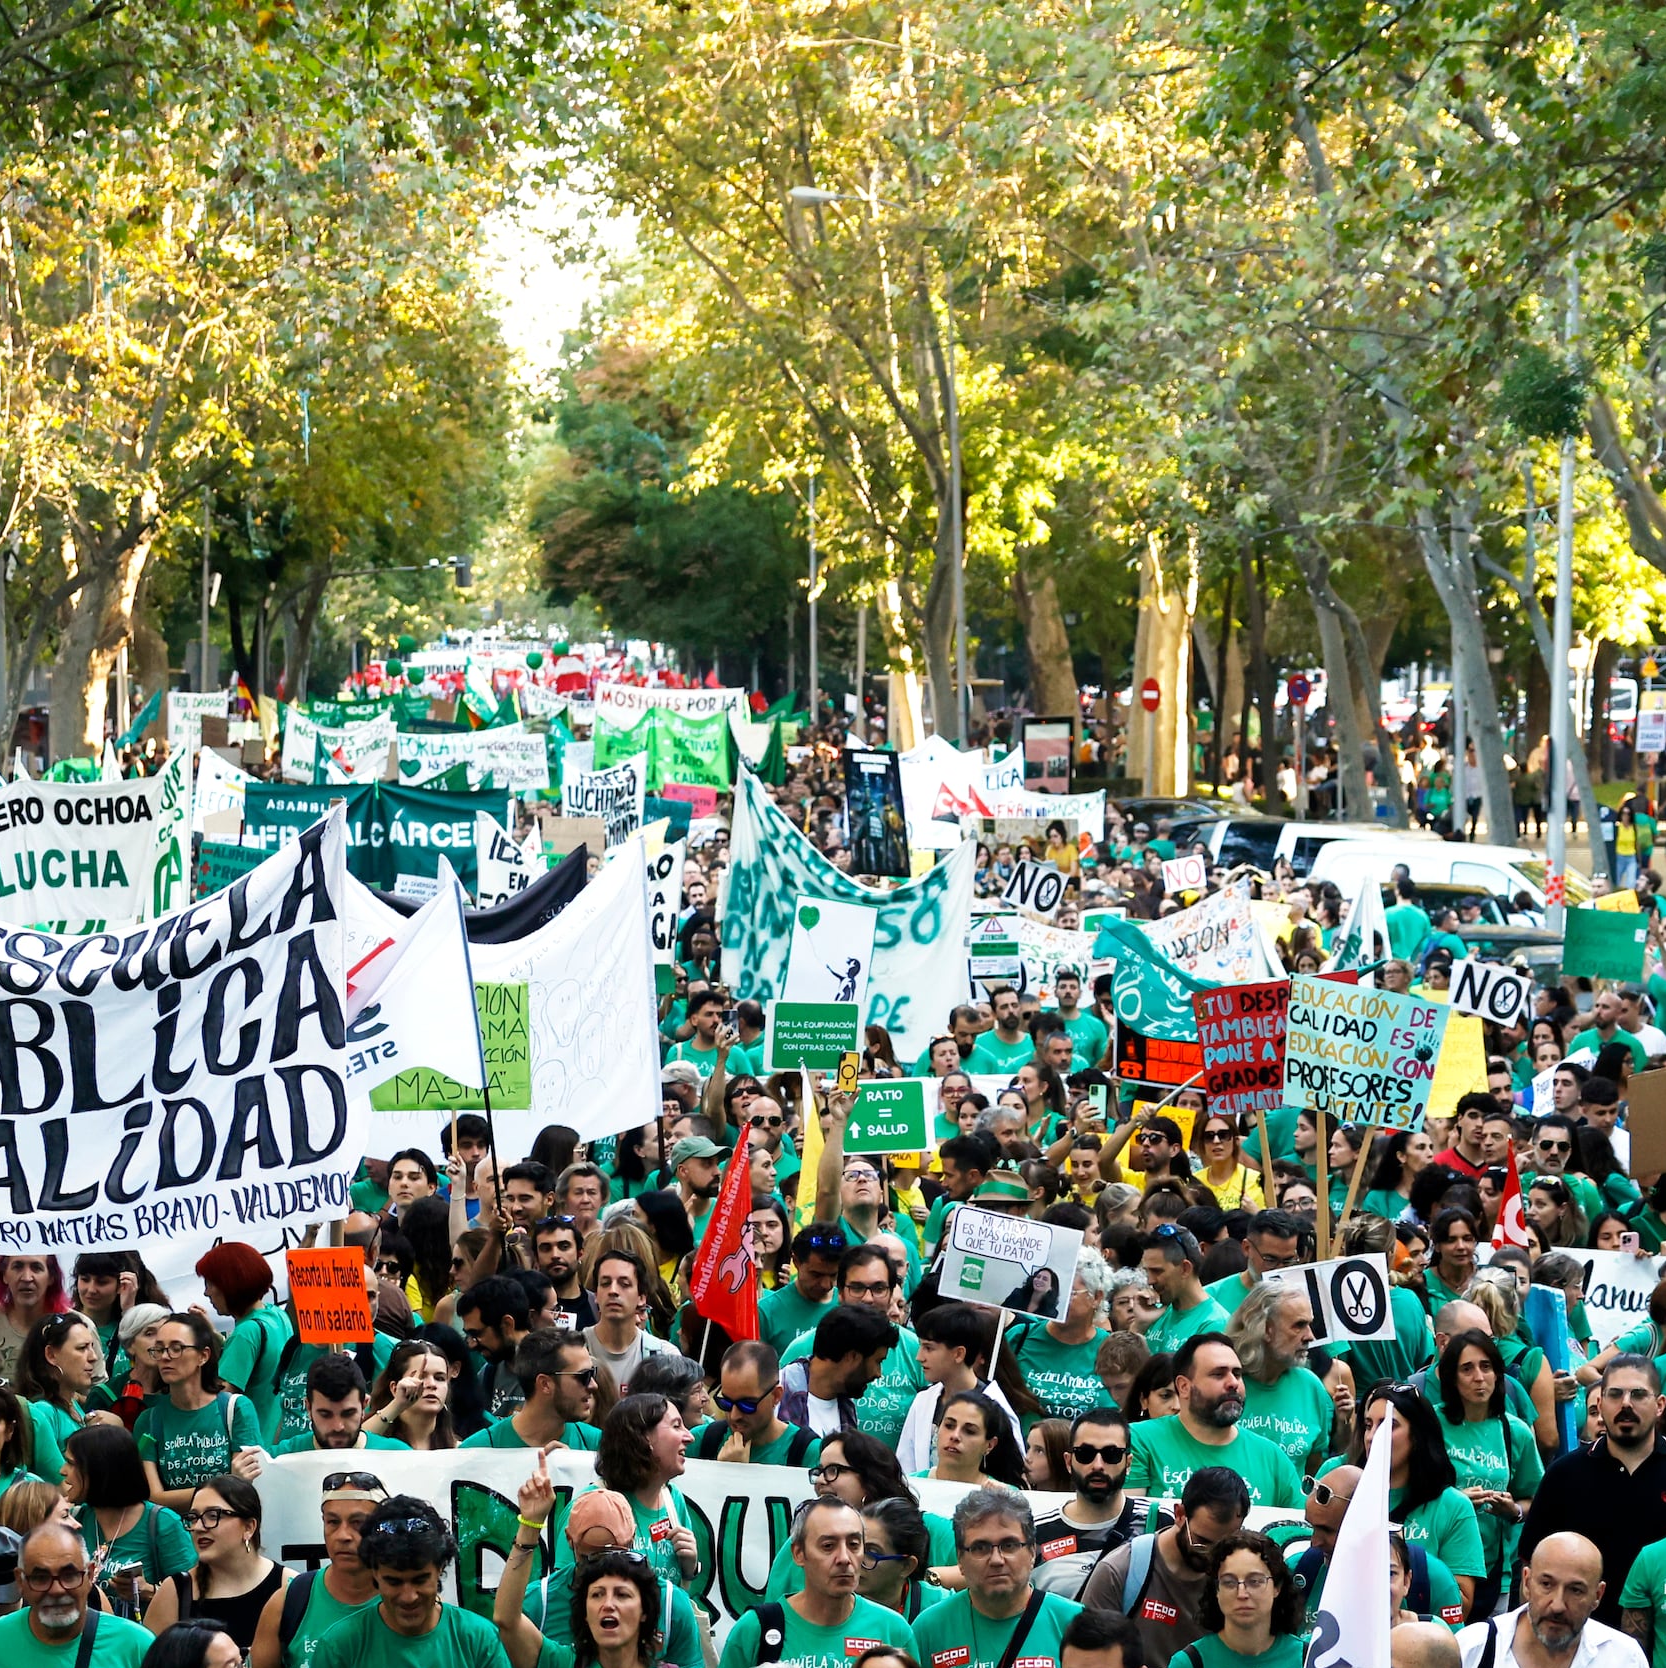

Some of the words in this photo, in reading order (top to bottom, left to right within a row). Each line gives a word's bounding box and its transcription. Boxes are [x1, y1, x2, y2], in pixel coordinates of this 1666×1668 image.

[53, 794, 153, 827] OCHOA
[1165, 860, 1202, 887] NO
[1453, 963, 1521, 1019] NO
[1289, 1005, 1378, 1043] CALIDAD
[1390, 1028, 1416, 1050] ES
[1410, 1007, 1437, 1028] DE
[1204, 1041, 1255, 1070] PONE
[1262, 1041, 1277, 1061] A
[1289, 1031, 1389, 1070] EDUCACIÓN
[1392, 1056, 1435, 1081] CON
[1209, 1065, 1280, 1094] GRADOS
[1287, 1058, 1414, 1104] PROFESORES
[867, 1089, 903, 1103] RATIO
[867, 1122, 909, 1137] SALUD
[133, 1193, 219, 1240] BRAVO
[966, 1239, 985, 1251] QUE
[991, 1240, 1002, 1254] TU
[1003, 1244, 1034, 1261] PATIO
[1002, 1232, 1043, 1252] GRANDE
[298, 1309, 313, 1329] no
[314, 1307, 326, 1329] mi
[327, 1307, 371, 1332] salario.
[1043, 1540, 1074, 1556] CCOO
